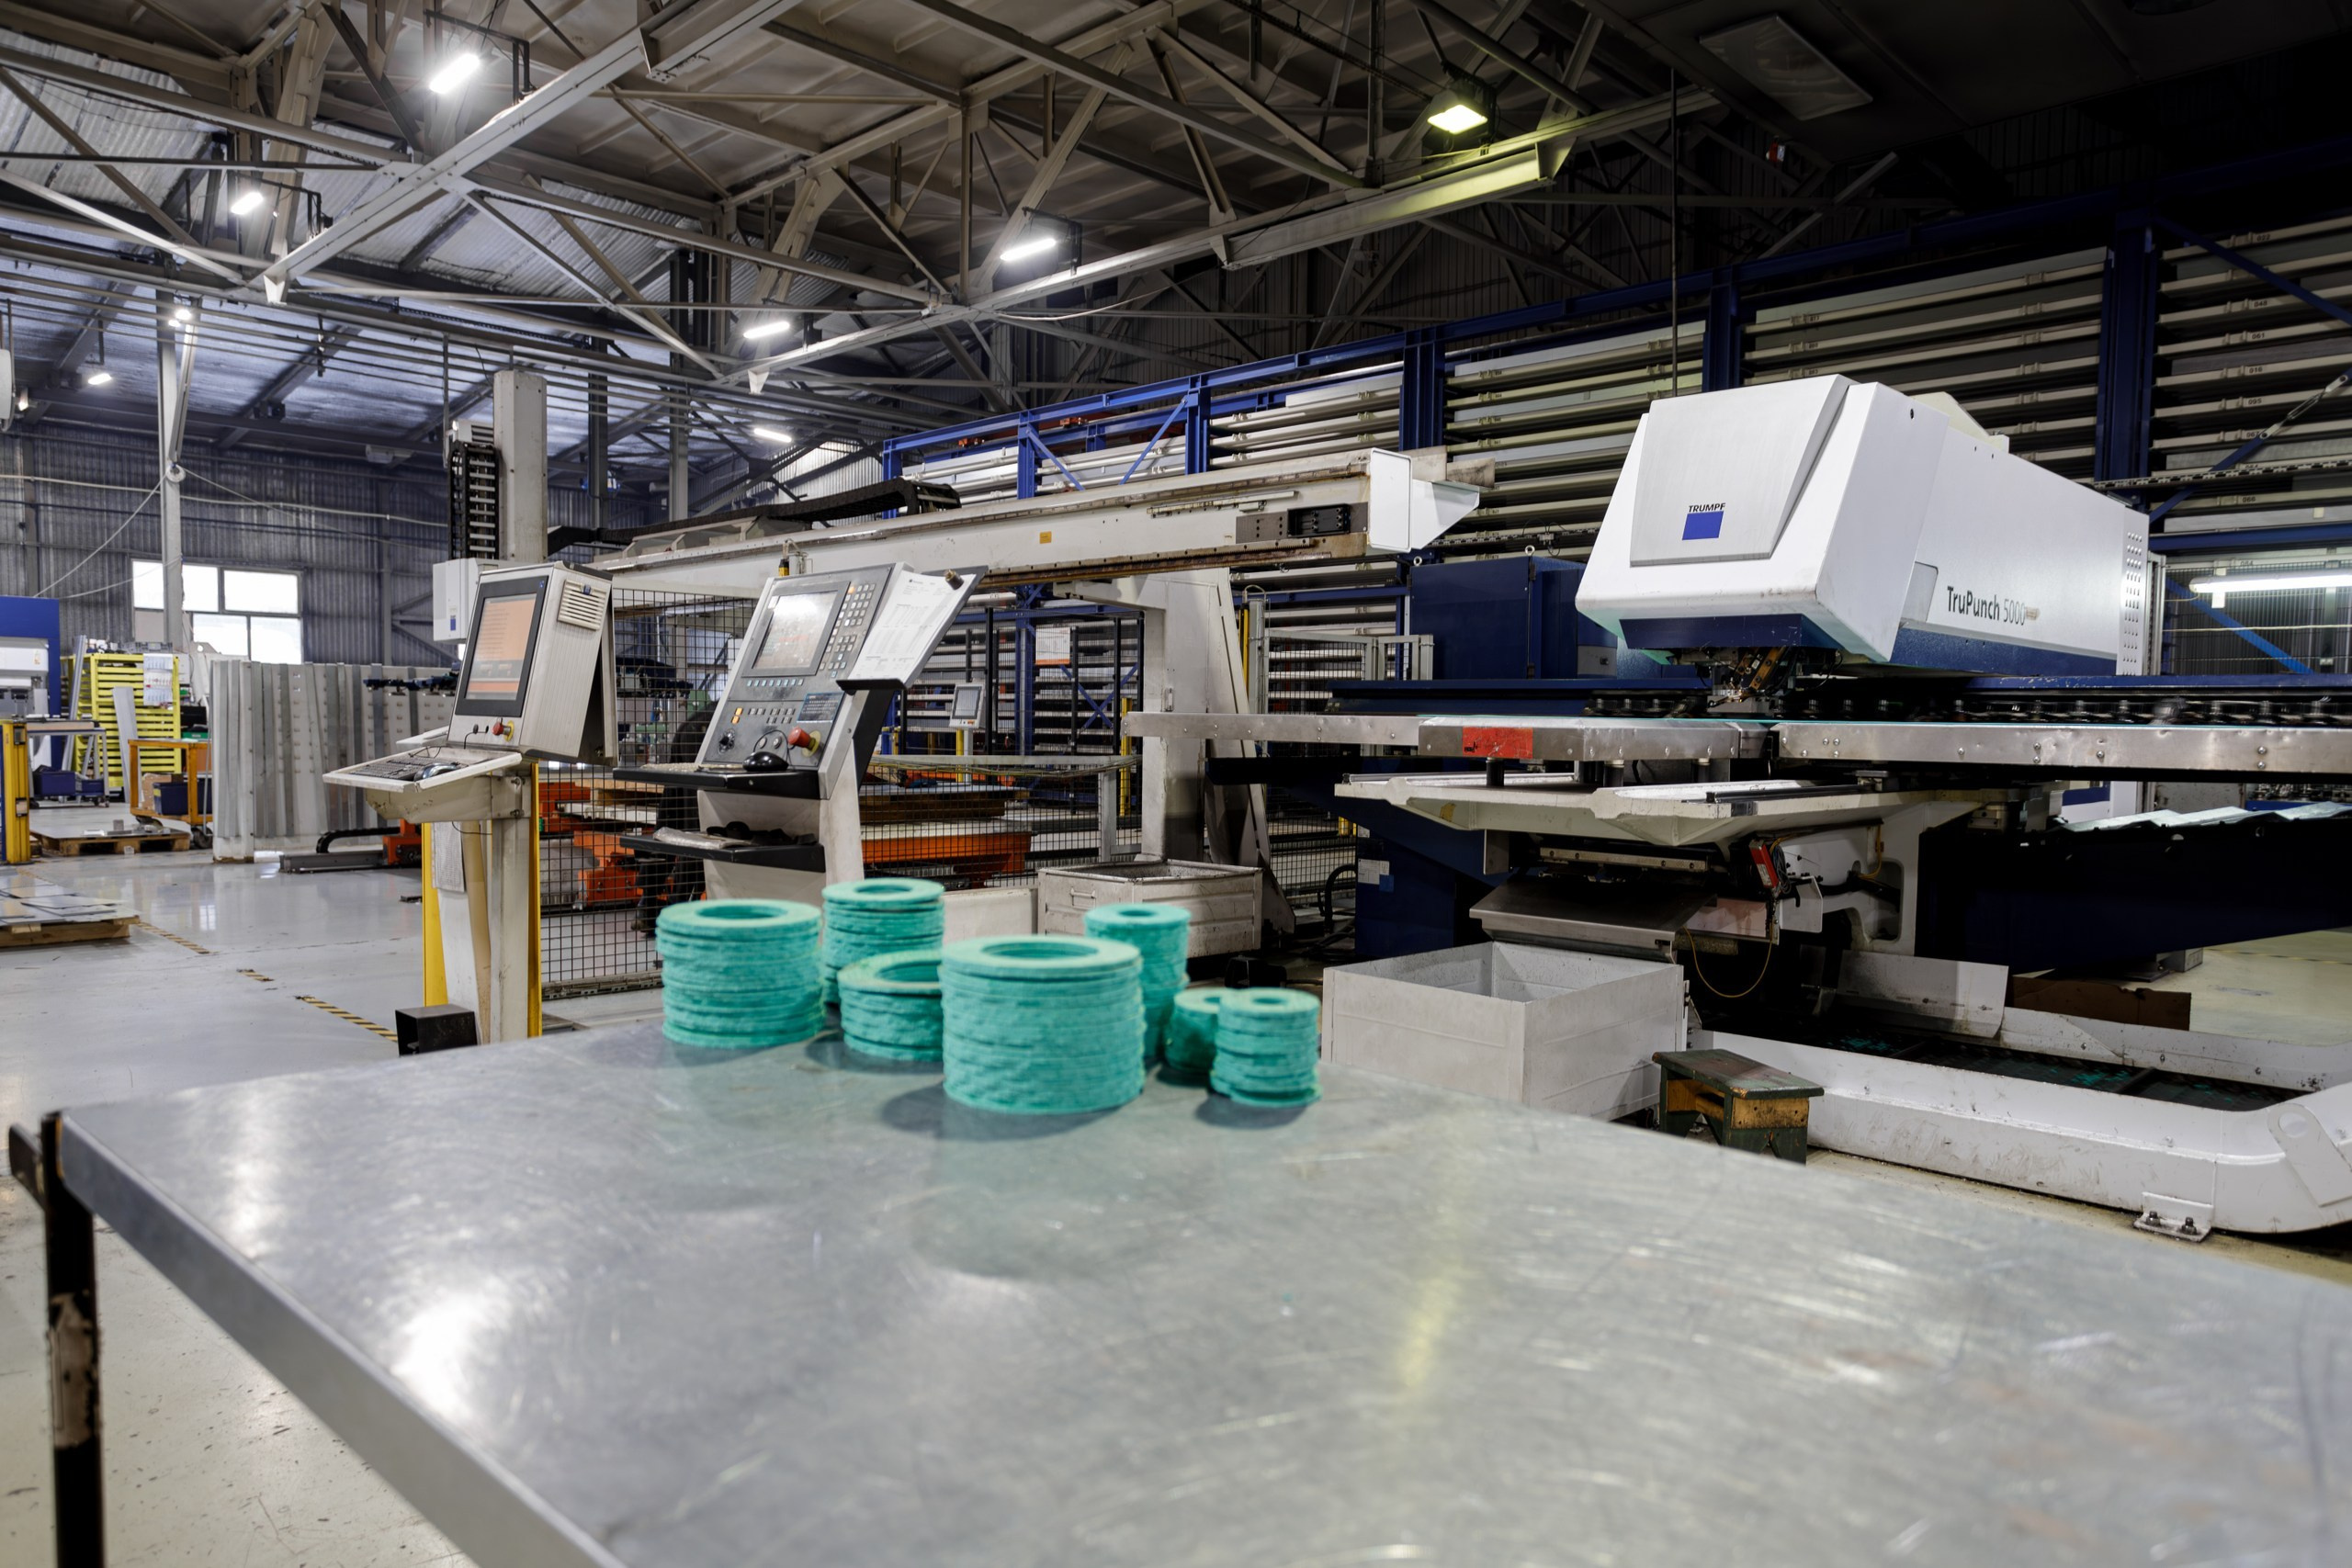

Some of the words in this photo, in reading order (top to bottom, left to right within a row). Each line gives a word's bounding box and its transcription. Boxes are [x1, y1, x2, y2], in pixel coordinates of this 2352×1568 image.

[1689, 502, 1726, 513] TRUMPF
[1947, 585, 2000, 621] TruPunch
[2003, 598, 2026, 626] 5000
